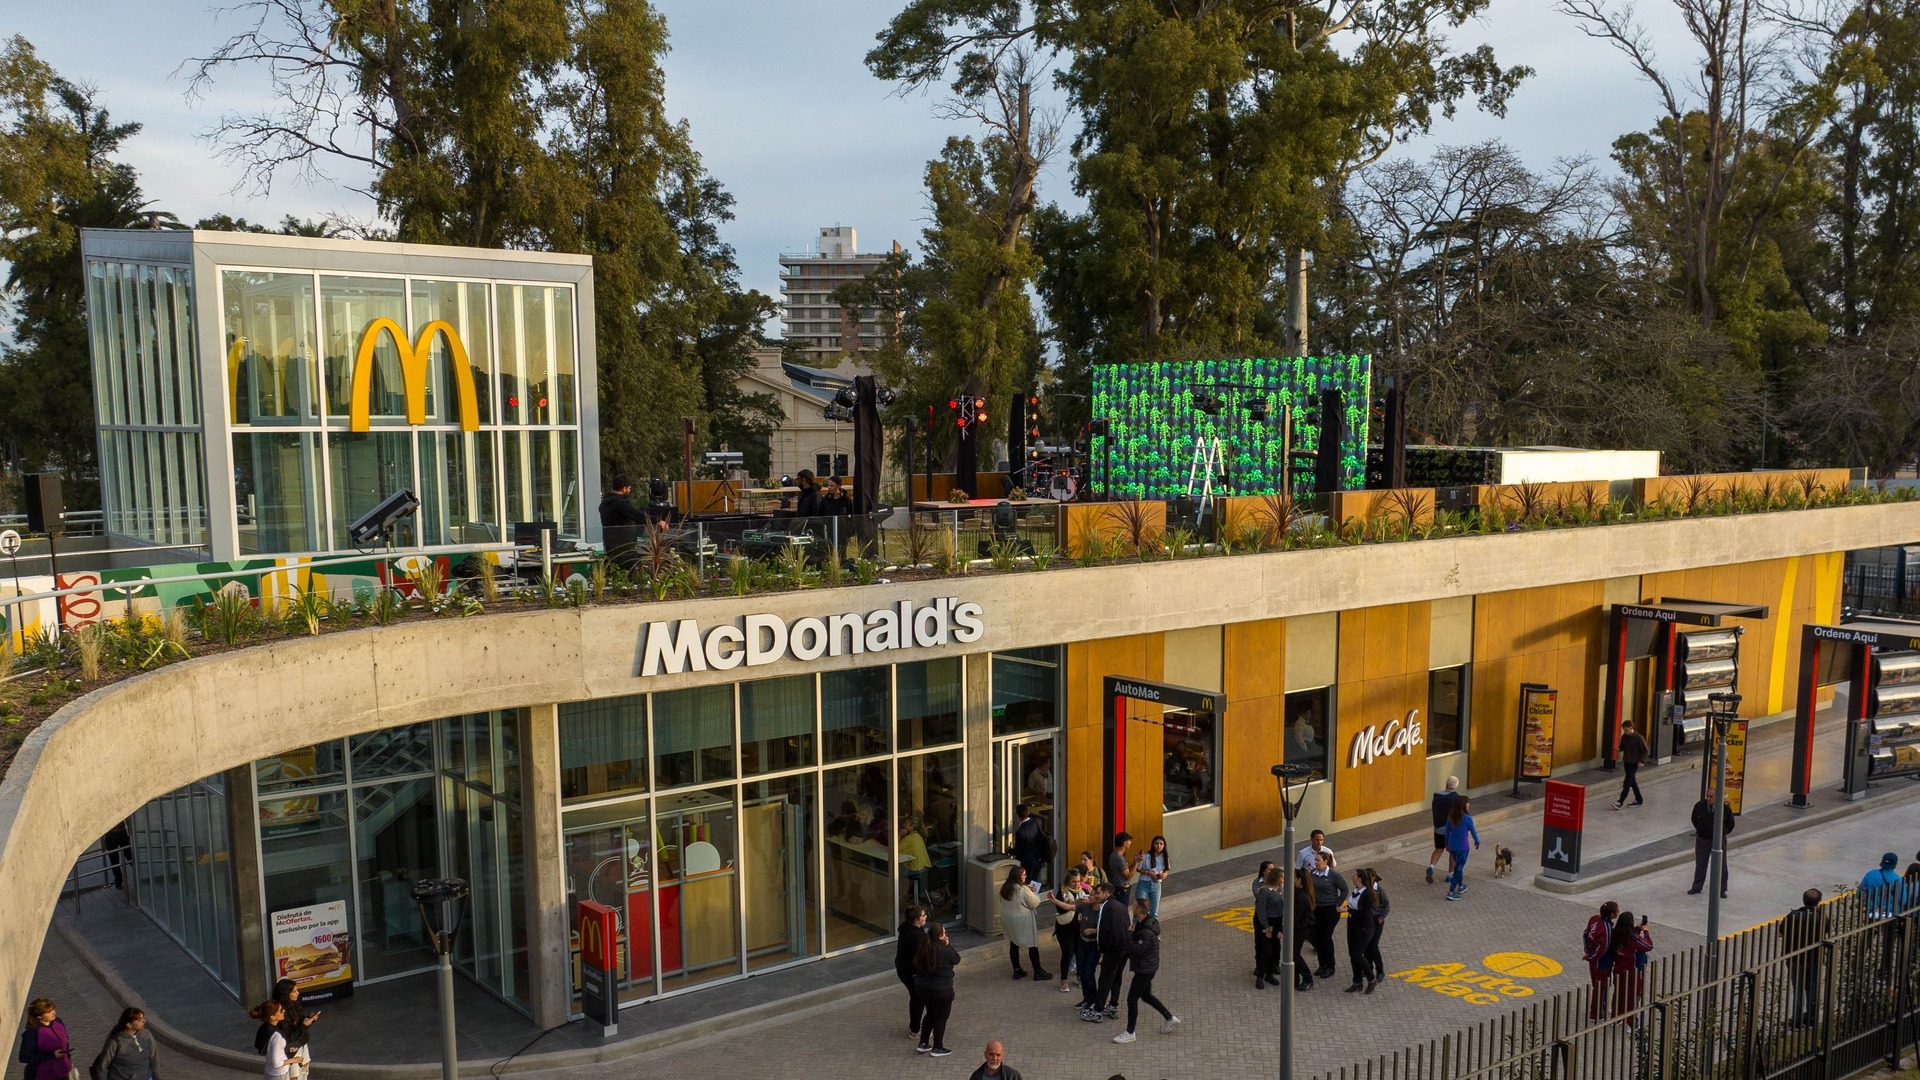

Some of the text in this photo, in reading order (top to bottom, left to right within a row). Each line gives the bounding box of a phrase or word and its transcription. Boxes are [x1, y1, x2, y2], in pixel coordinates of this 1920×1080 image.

[1621, 606, 1653, 618] Ordene
[1654, 610, 1677, 621] Aquí
[641, 596, 985, 677] McDonald's
[1814, 626, 1851, 640] Ordene
[1853, 633, 1878, 644] Aquí
[1114, 681, 1160, 700] AutoMac
[1529, 707, 1553, 715] Chicken
[1552, 802, 1571, 810] carriles
[1553, 796, 1571, 804] Ambos
[1551, 808, 1571, 817] abiertos
[276, 910, 303, 920] Disfrutá
[277, 925, 308, 935] exclusivo
[1416, 962, 1536, 997] Auto
[1388, 968, 1500, 1005] Mac
